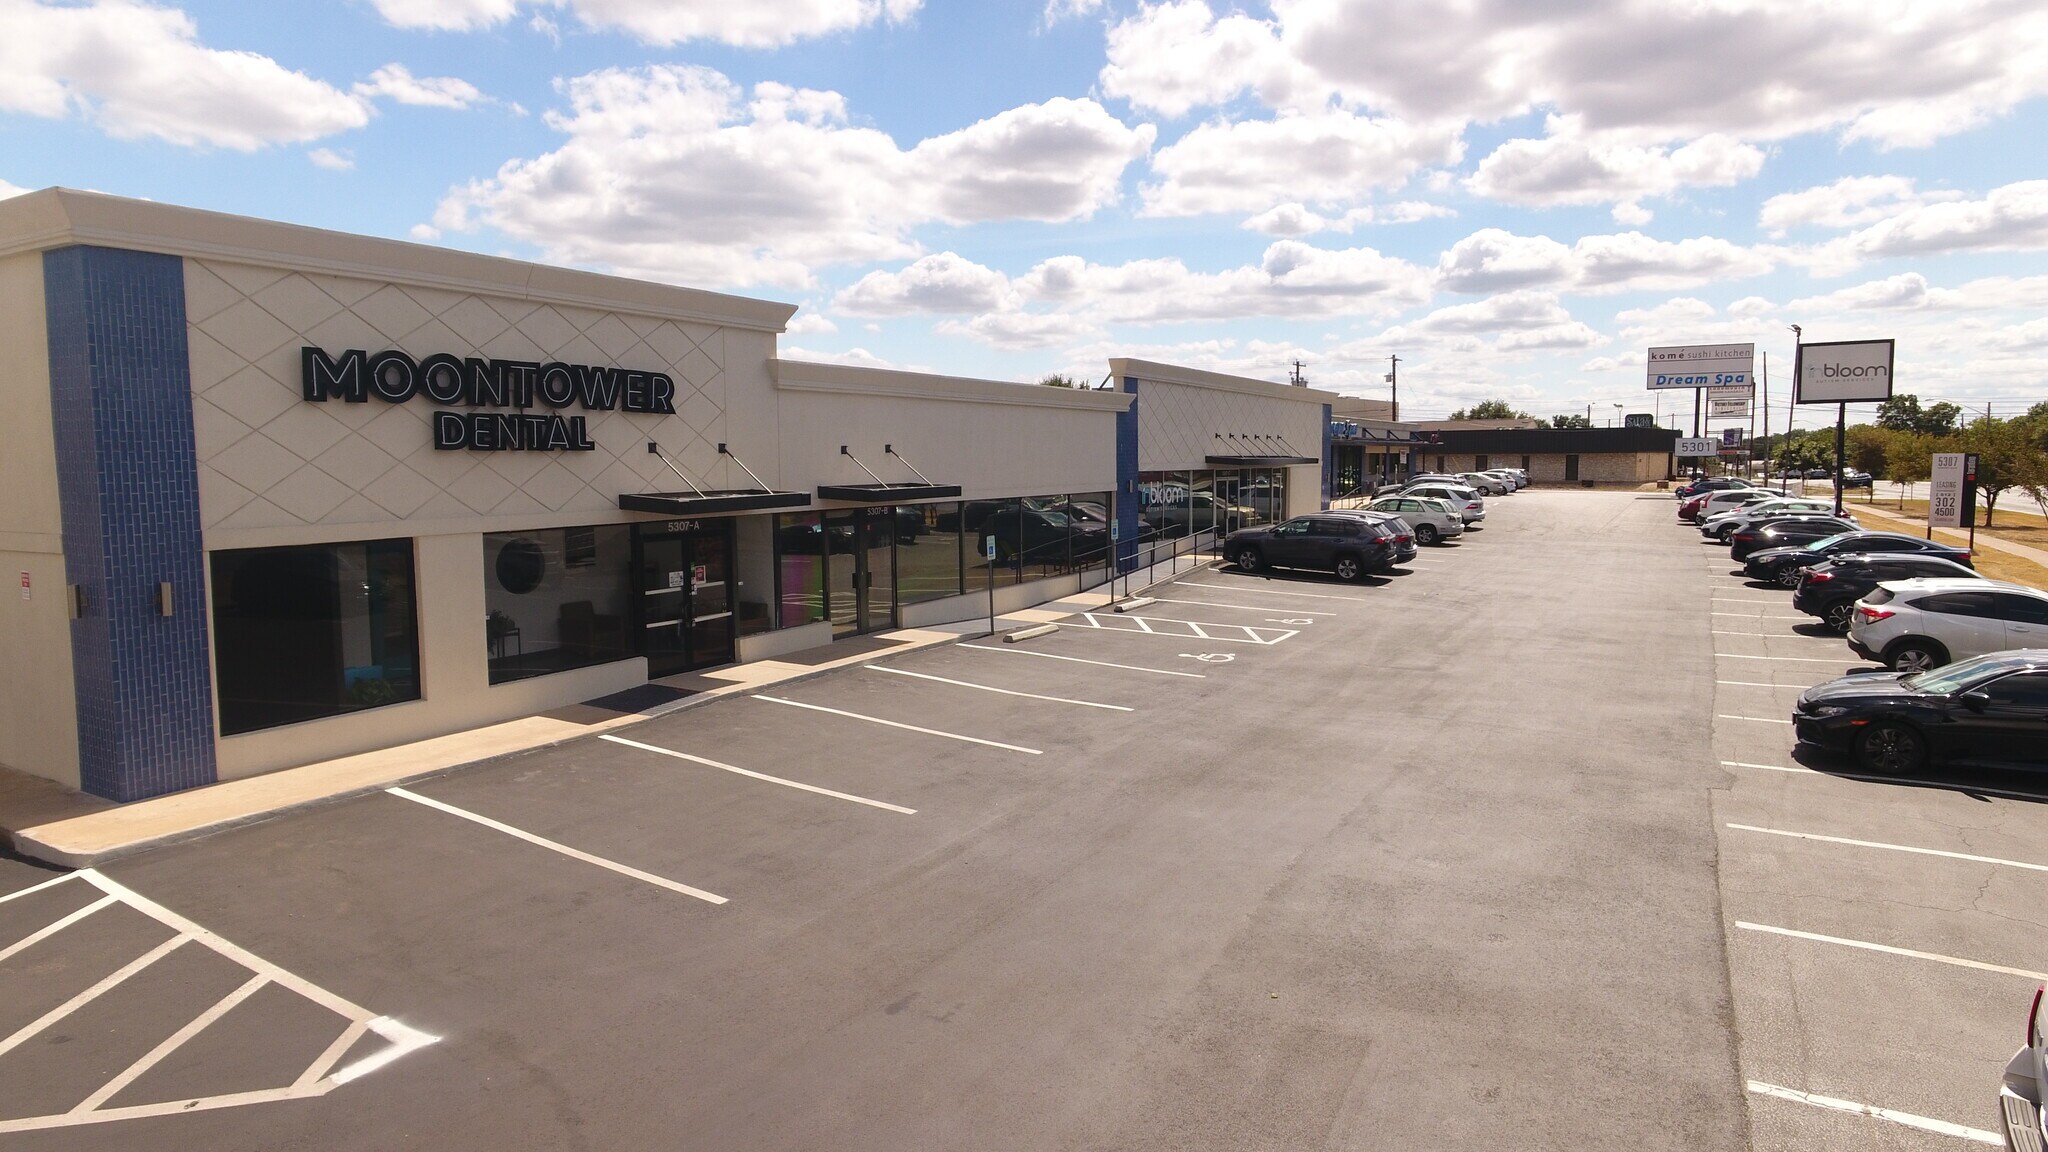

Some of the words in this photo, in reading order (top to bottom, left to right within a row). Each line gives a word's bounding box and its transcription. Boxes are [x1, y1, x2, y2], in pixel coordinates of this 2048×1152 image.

[1651, 349, 1685, 360] komé
[1687, 350, 1712, 359] sushi
[1714, 348, 1751, 358] kitchen
[301, 346, 677, 415] MOONTOWER
[1656, 375, 1708, 386] Dream
[1714, 373, 1745, 386] Spa
[433, 410, 595, 451] DENTAL
[1681, 442, 1711, 452] 5301
[1938, 457, 1958, 466] 5307
[1936, 481, 1957, 489] LEASING
[1935, 498, 1955, 507] 302
[867, 506, 889, 516] 5307-B
[1935, 508, 1955, 516] 4500
[668, 520, 700, 532] 5307-A
